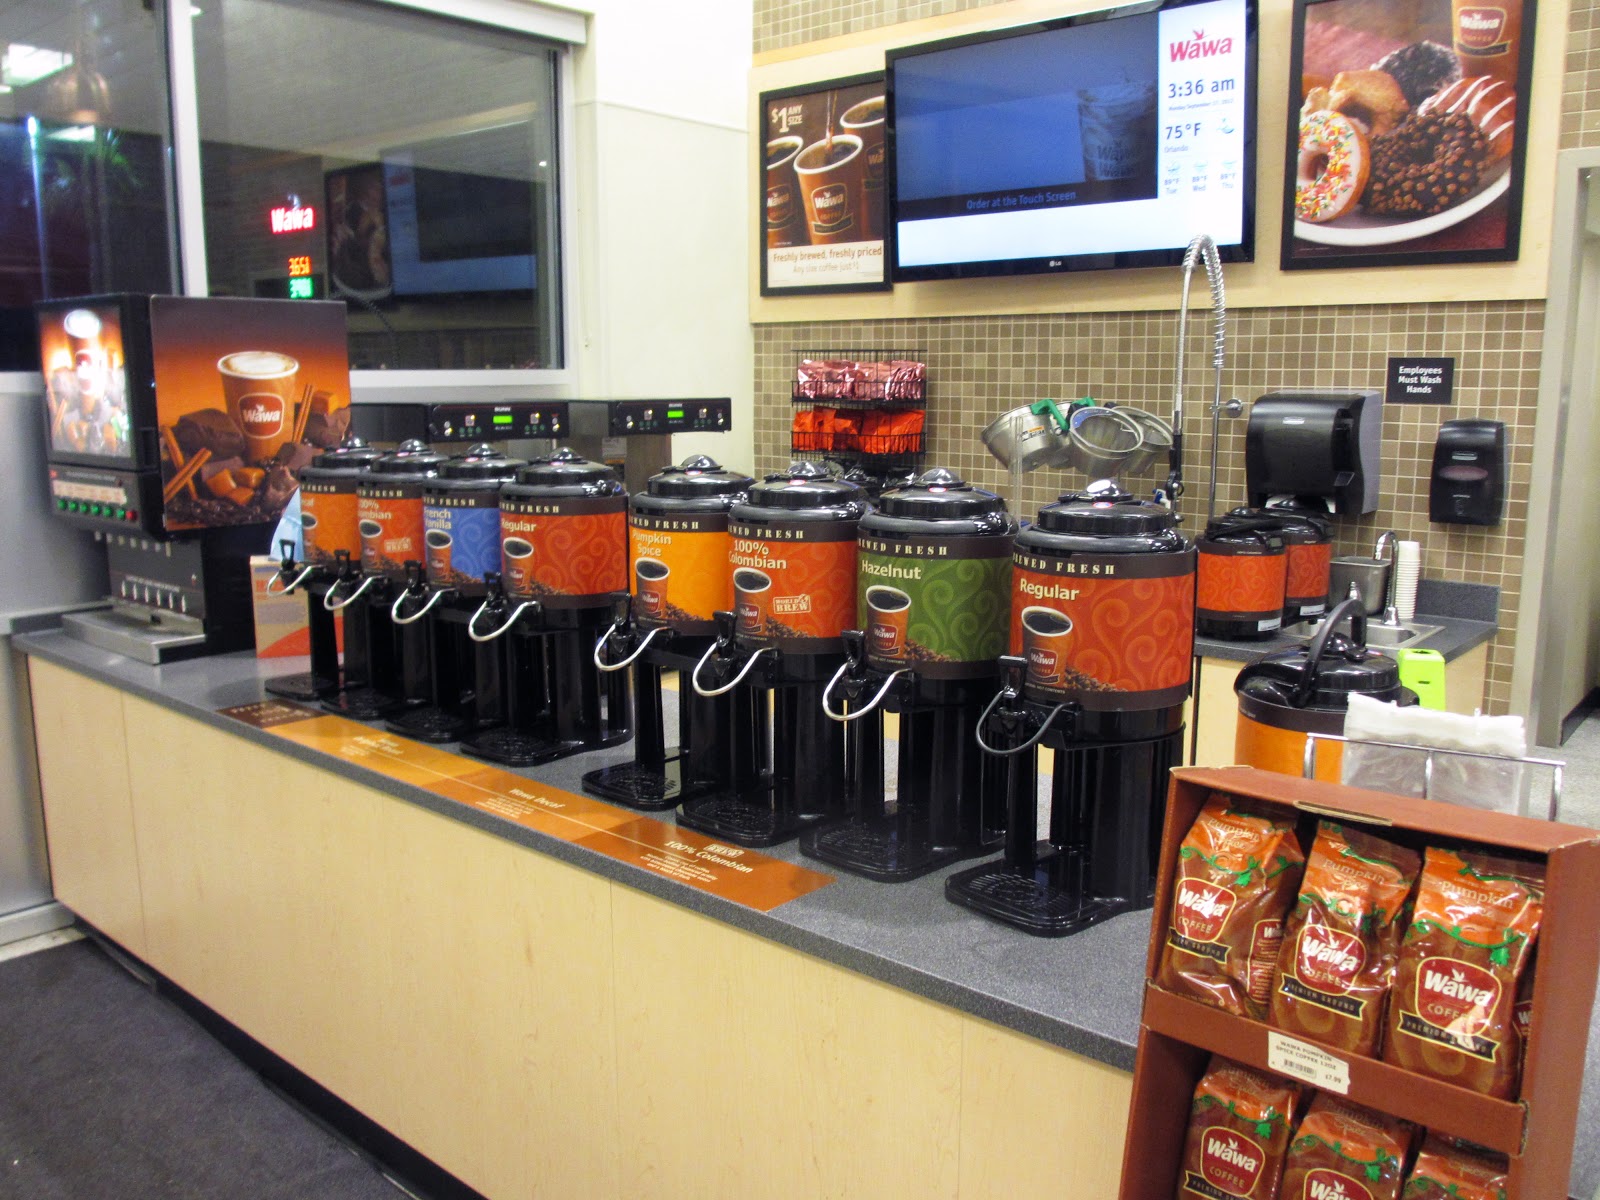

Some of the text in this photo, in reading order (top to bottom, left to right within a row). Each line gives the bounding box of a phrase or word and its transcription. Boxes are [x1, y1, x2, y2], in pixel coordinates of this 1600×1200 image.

[1460, 15, 1500, 30] Wawa
[1169, 37, 1233, 62] Wawa
[1168, 78, 1235, 98] 3:36 am
[788, 104, 803, 115] ANY
[771, 106, 789, 133] $1
[788, 115, 803, 126] SIZE
[1165, 122, 1202, 140] 75°F
[815, 193, 844, 209] Wawa
[966, 191, 1077, 210] Order at the Touch Screen
[270, 206, 315, 234] Wawa
[773, 245, 882, 263] Freshly brewed, freshly priced
[1399, 366, 1443, 376] Employees
[1397, 376, 1442, 384] Must Wash
[1406, 385, 1432, 393] Hands
[242, 411, 281, 423] Wawa
[439, 498, 475, 506] FRESH
[520, 504, 560, 513] FRESH
[655, 520, 699, 530] FRESH
[632, 529, 672, 545] Pumpkin
[757, 528, 804, 539] FRESH
[637, 543, 662, 557] Spice
[734, 540, 769, 555] 100%
[895, 544, 948, 556] FRESH
[728, 550, 787, 569] Colombian
[861, 560, 922, 580] Hazelnut
[1056, 561, 1116, 575] FRESH
[1020, 578, 1080, 601] Regular
[740, 606, 758, 617] Wawa
[776, 604, 808, 612] BREW
[873, 628, 896, 639] Wawa
[1030, 653, 1055, 665] Wawa
[664, 840, 698, 855] 100%
[696, 851, 754, 874] Colombian
[1322, 858, 1386, 884] Pumpkin
[1441, 880, 1514, 909] Pumpkin
[1177, 916, 1214, 934] COFFEE
[1303, 936, 1360, 971] Wawa
[1424, 970, 1494, 1007] Wawa
[1295, 1052, 1318, 1064] COFFEE
[1207, 1137, 1257, 1173] Wawa
[1209, 1165, 1246, 1188] COFFEE
